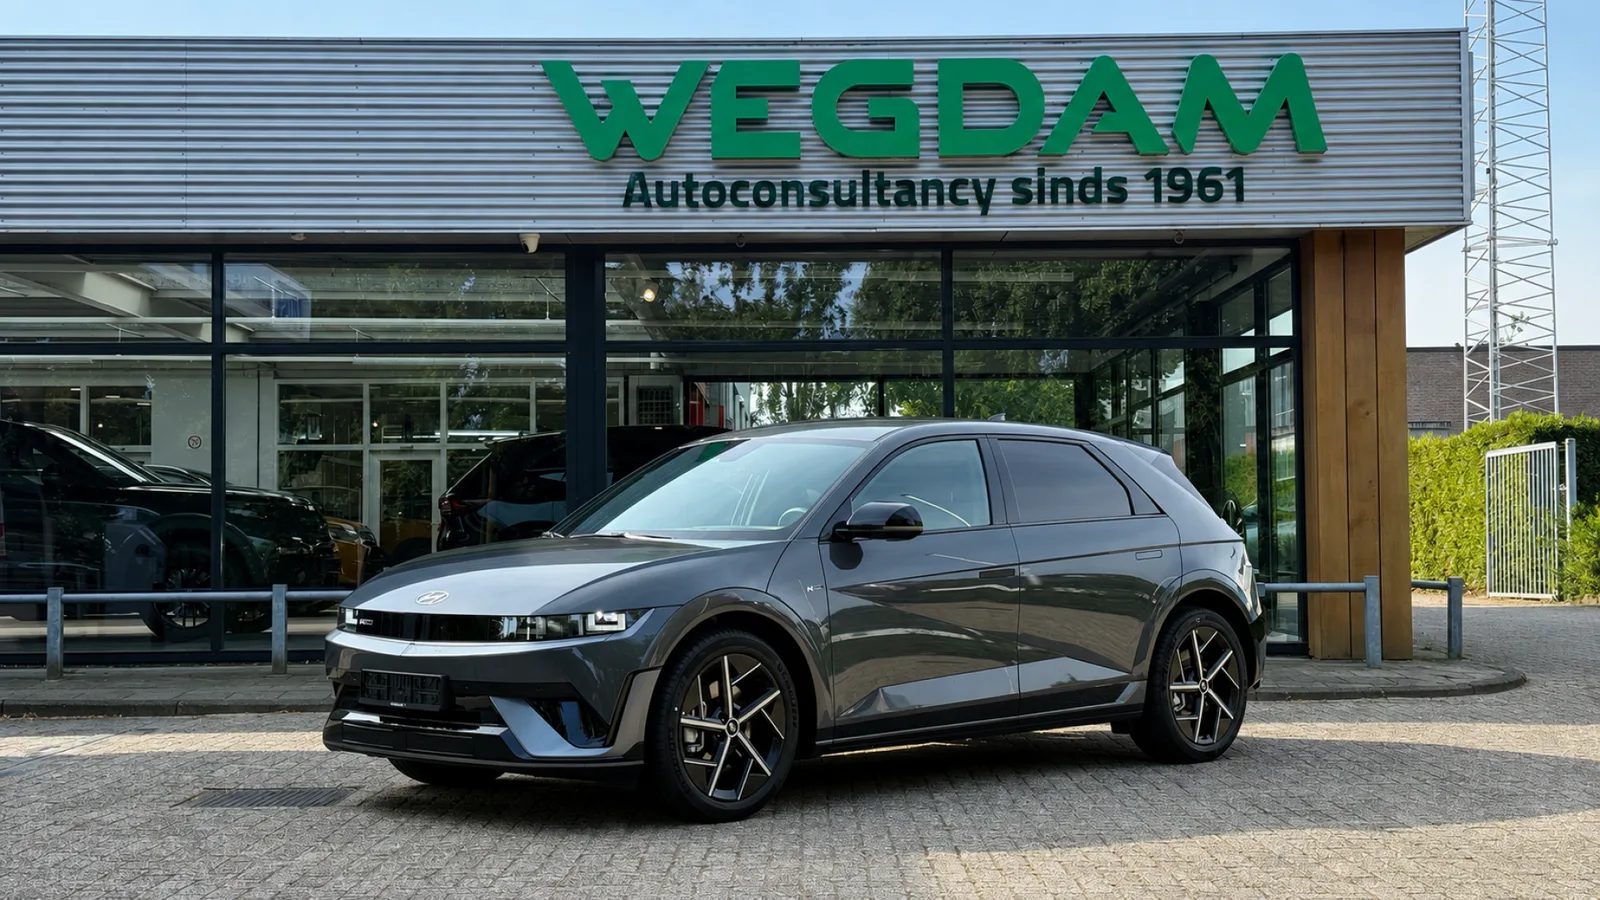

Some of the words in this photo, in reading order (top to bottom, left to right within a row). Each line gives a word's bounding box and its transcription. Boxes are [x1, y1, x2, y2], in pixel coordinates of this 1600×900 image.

[541, 53, 1327, 162] WEGDAM
[622, 169, 996, 216] Autoconsultancy
[1011, 166, 1128, 206] sinds
[1144, 166, 1245, 203] 1961
